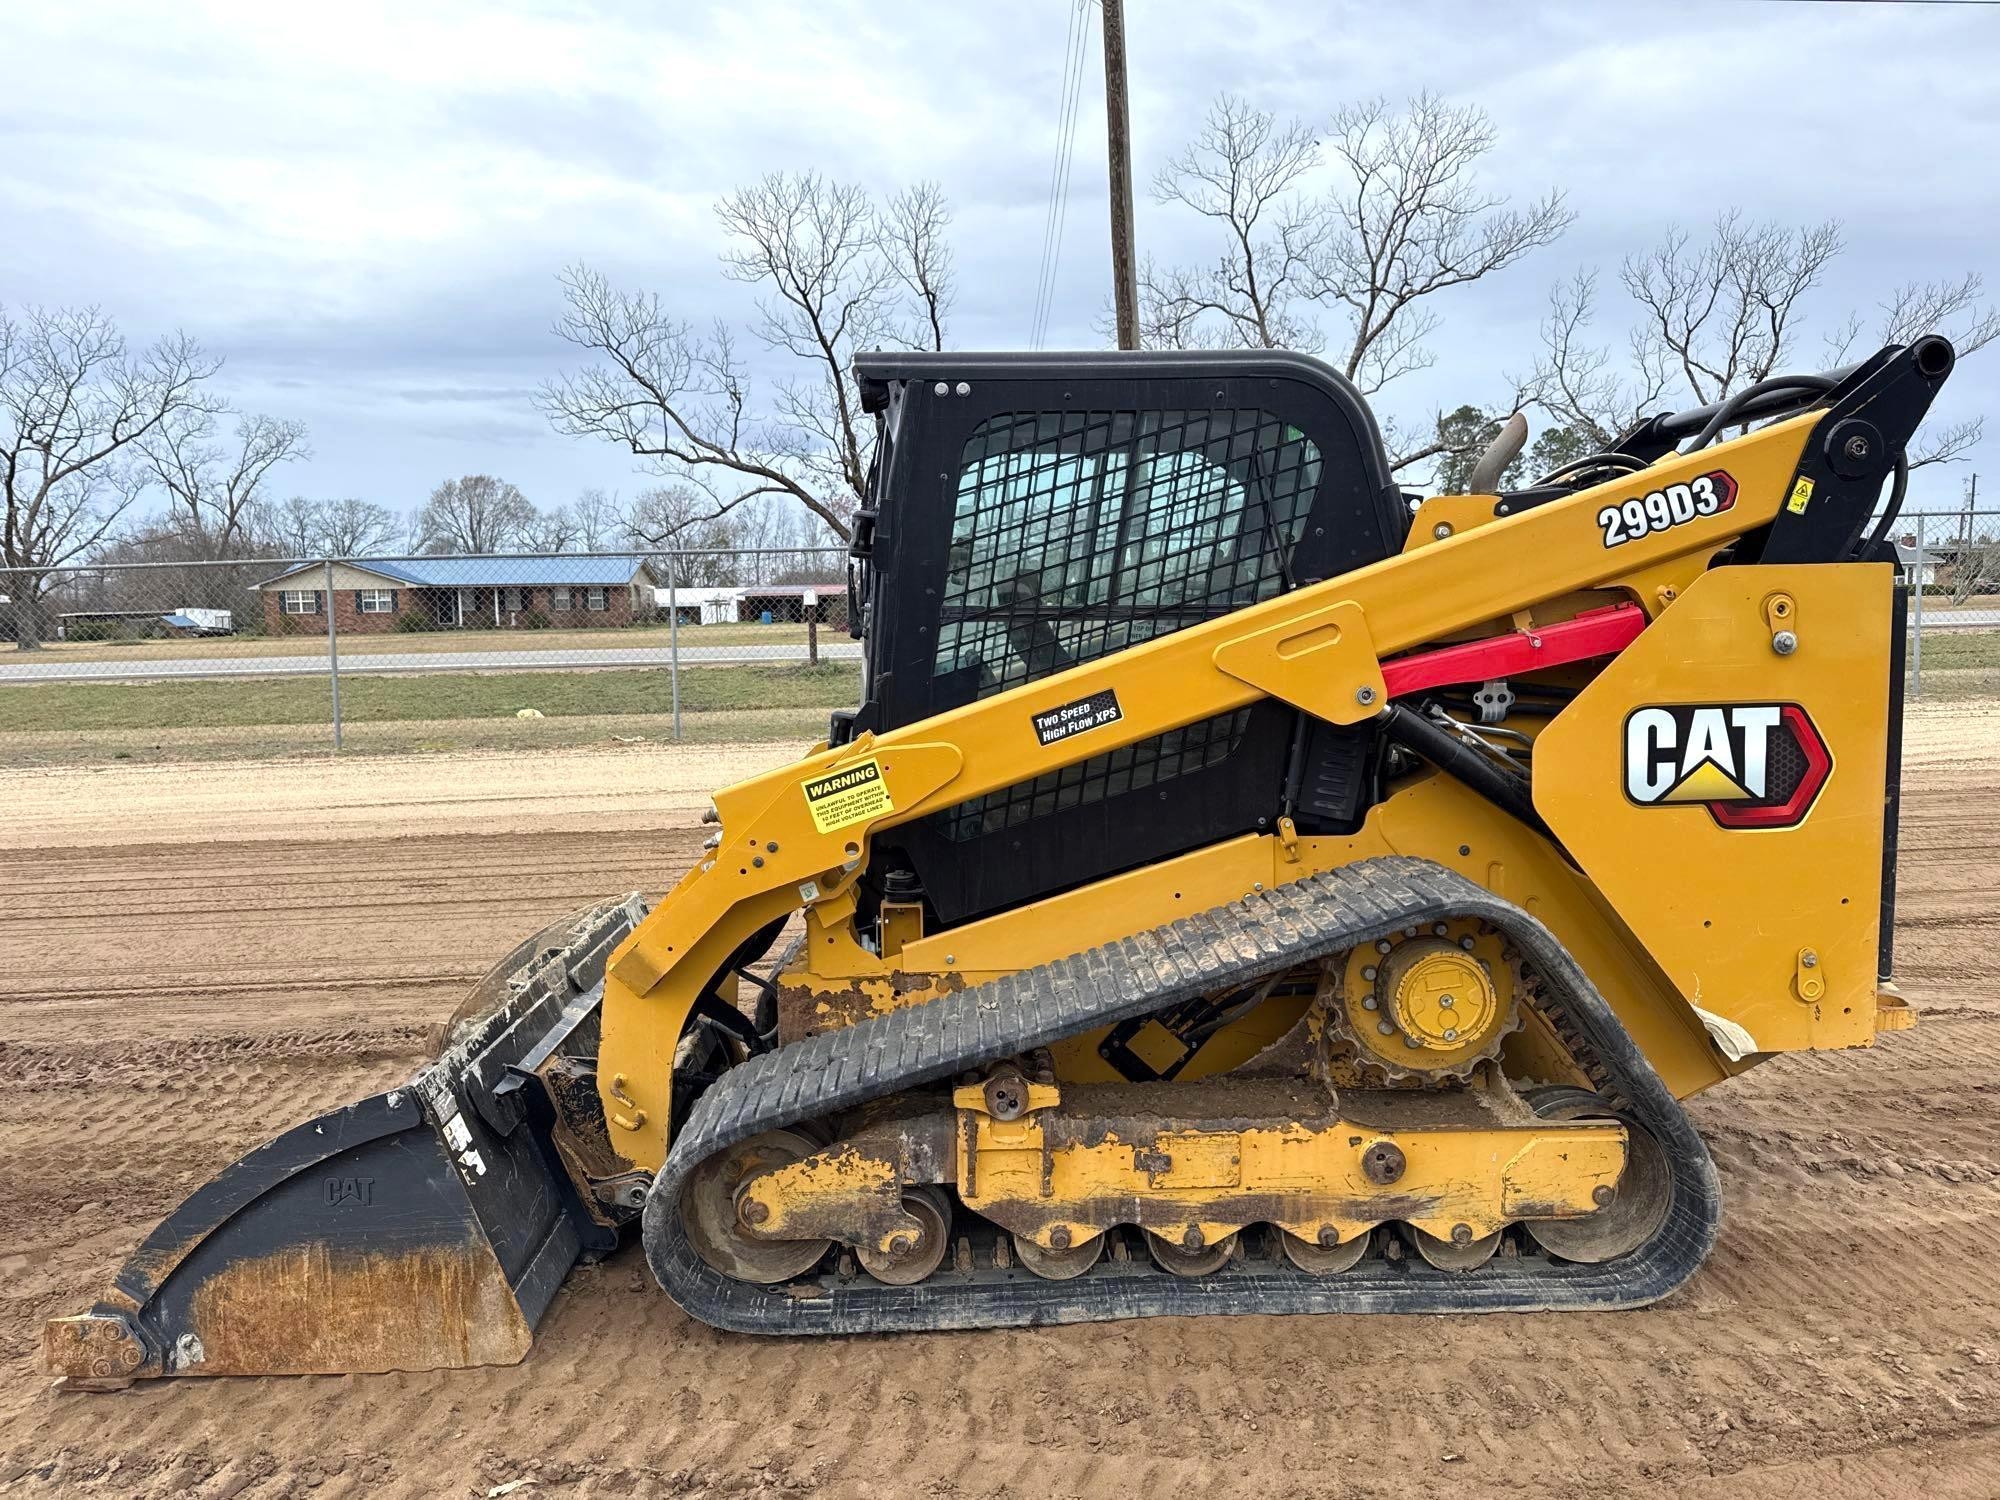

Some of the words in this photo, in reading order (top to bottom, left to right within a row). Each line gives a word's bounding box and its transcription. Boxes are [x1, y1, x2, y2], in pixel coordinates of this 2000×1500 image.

[1600, 477, 1718, 546] 299D3
[1037, 714, 1059, 729] TWO
[1060, 703, 1090, 723] SPEED
[1042, 726, 1066, 742] HIGH
[1068, 716, 1093, 733] FLOW
[1095, 707, 1117, 723] XPS
[1628, 706, 1781, 802] CAT
[810, 767, 875, 797] WARNING
[815, 798, 846, 811] UNLAWFUL
[856, 785, 881, 797] OPERATE
[816, 809, 830, 818] THIS
[831, 798, 863, 813] EQUIPMENT
[864, 790, 885, 801] WITHIN
[830, 811, 843, 820] FEET
[853, 797, 883, 811] OVERHEAD
[825, 819, 840, 827] HIGH
[841, 810, 866, 821] VOLTAGE
[867, 804, 883, 813] LINES
[323, 1177, 374, 1207] CAT
